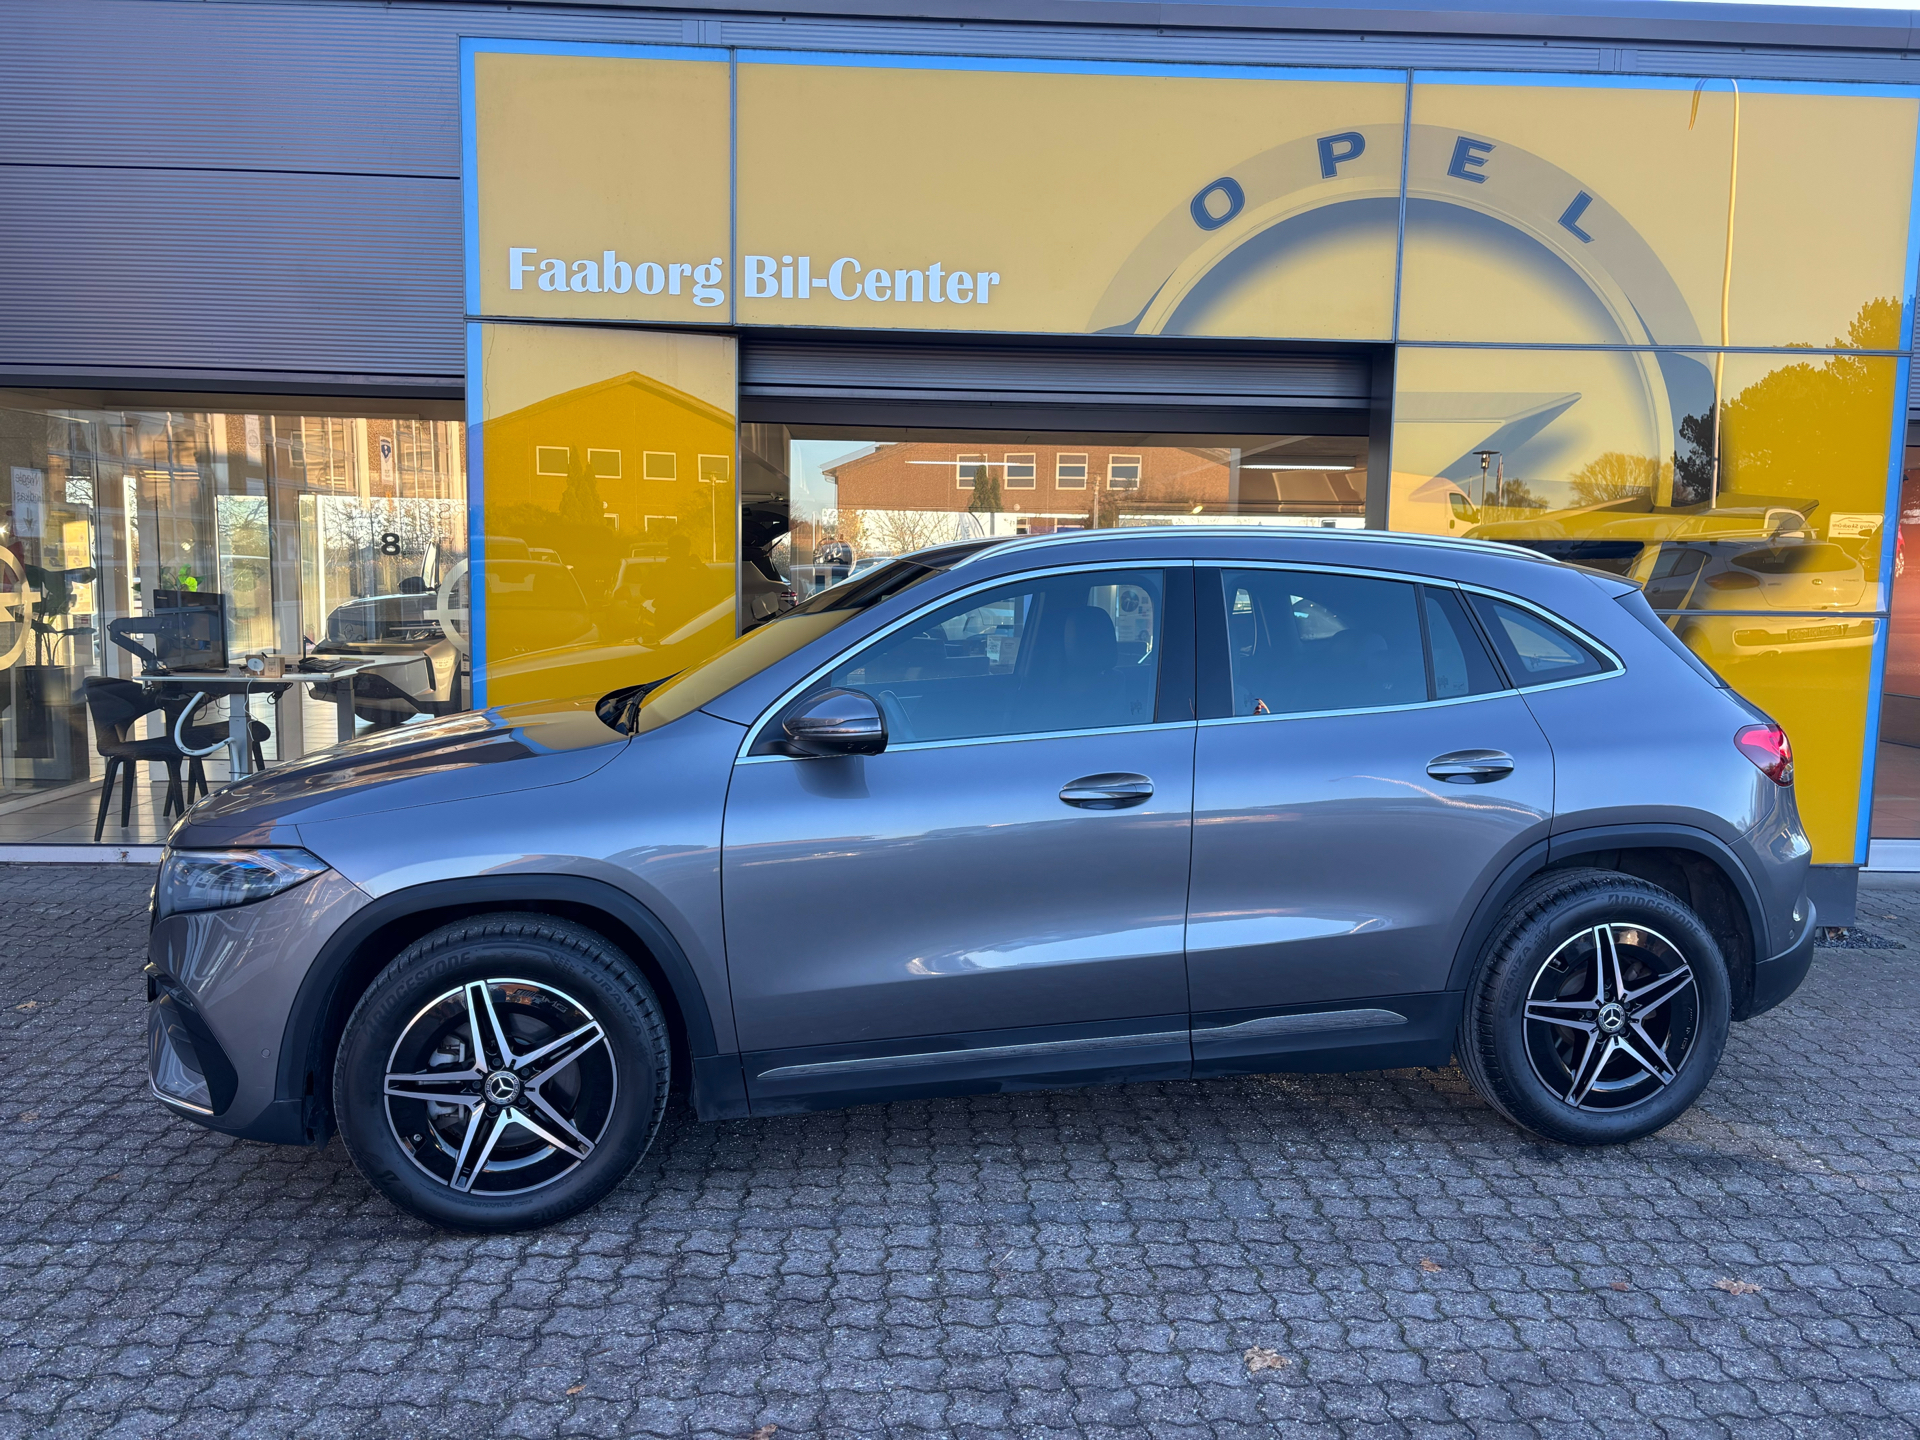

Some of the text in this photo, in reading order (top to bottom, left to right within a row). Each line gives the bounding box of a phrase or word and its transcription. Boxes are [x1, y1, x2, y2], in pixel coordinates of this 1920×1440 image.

[1190, 131, 1596, 244] OPEL
[509, 247, 1001, 307] Faaborg Bil-Center
[381, 532, 401, 556] 8
[1607, 894, 1701, 937] BRIDGESTONE
[364, 951, 471, 1037] BRIDGESTONE
[582, 965, 641, 1036] TURANZA
[1498, 946, 1532, 1021] TURANZA
